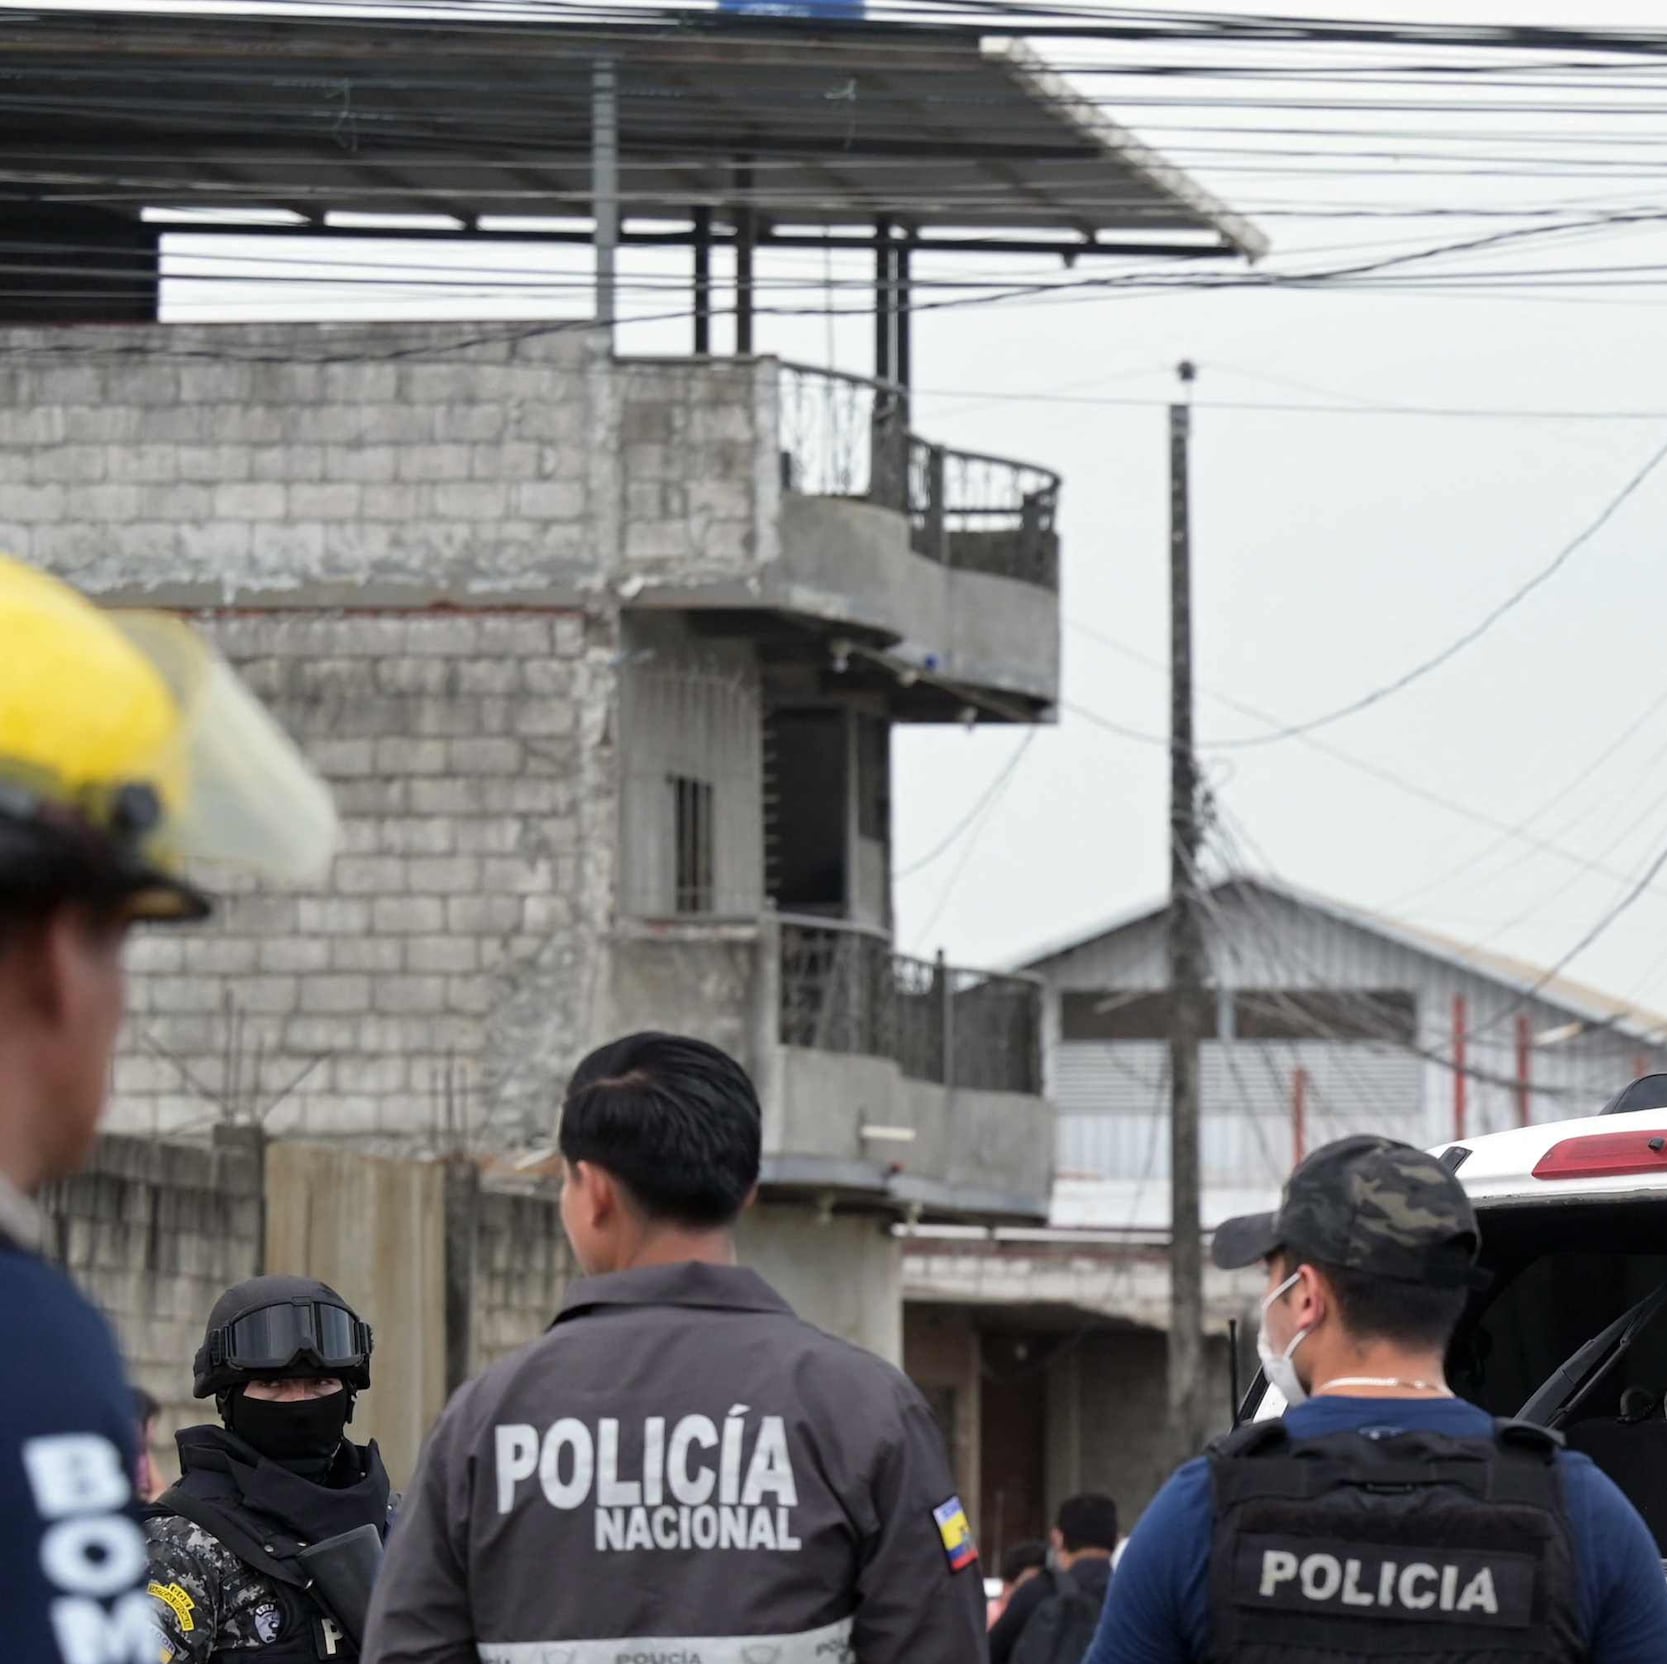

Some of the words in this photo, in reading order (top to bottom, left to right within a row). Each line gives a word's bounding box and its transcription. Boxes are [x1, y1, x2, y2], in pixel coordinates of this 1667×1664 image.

[494, 1403, 798, 1514] POLICÍA
[595, 1505, 801, 1551] NACIONAL
[1259, 1549, 1498, 1614] POLICIA
